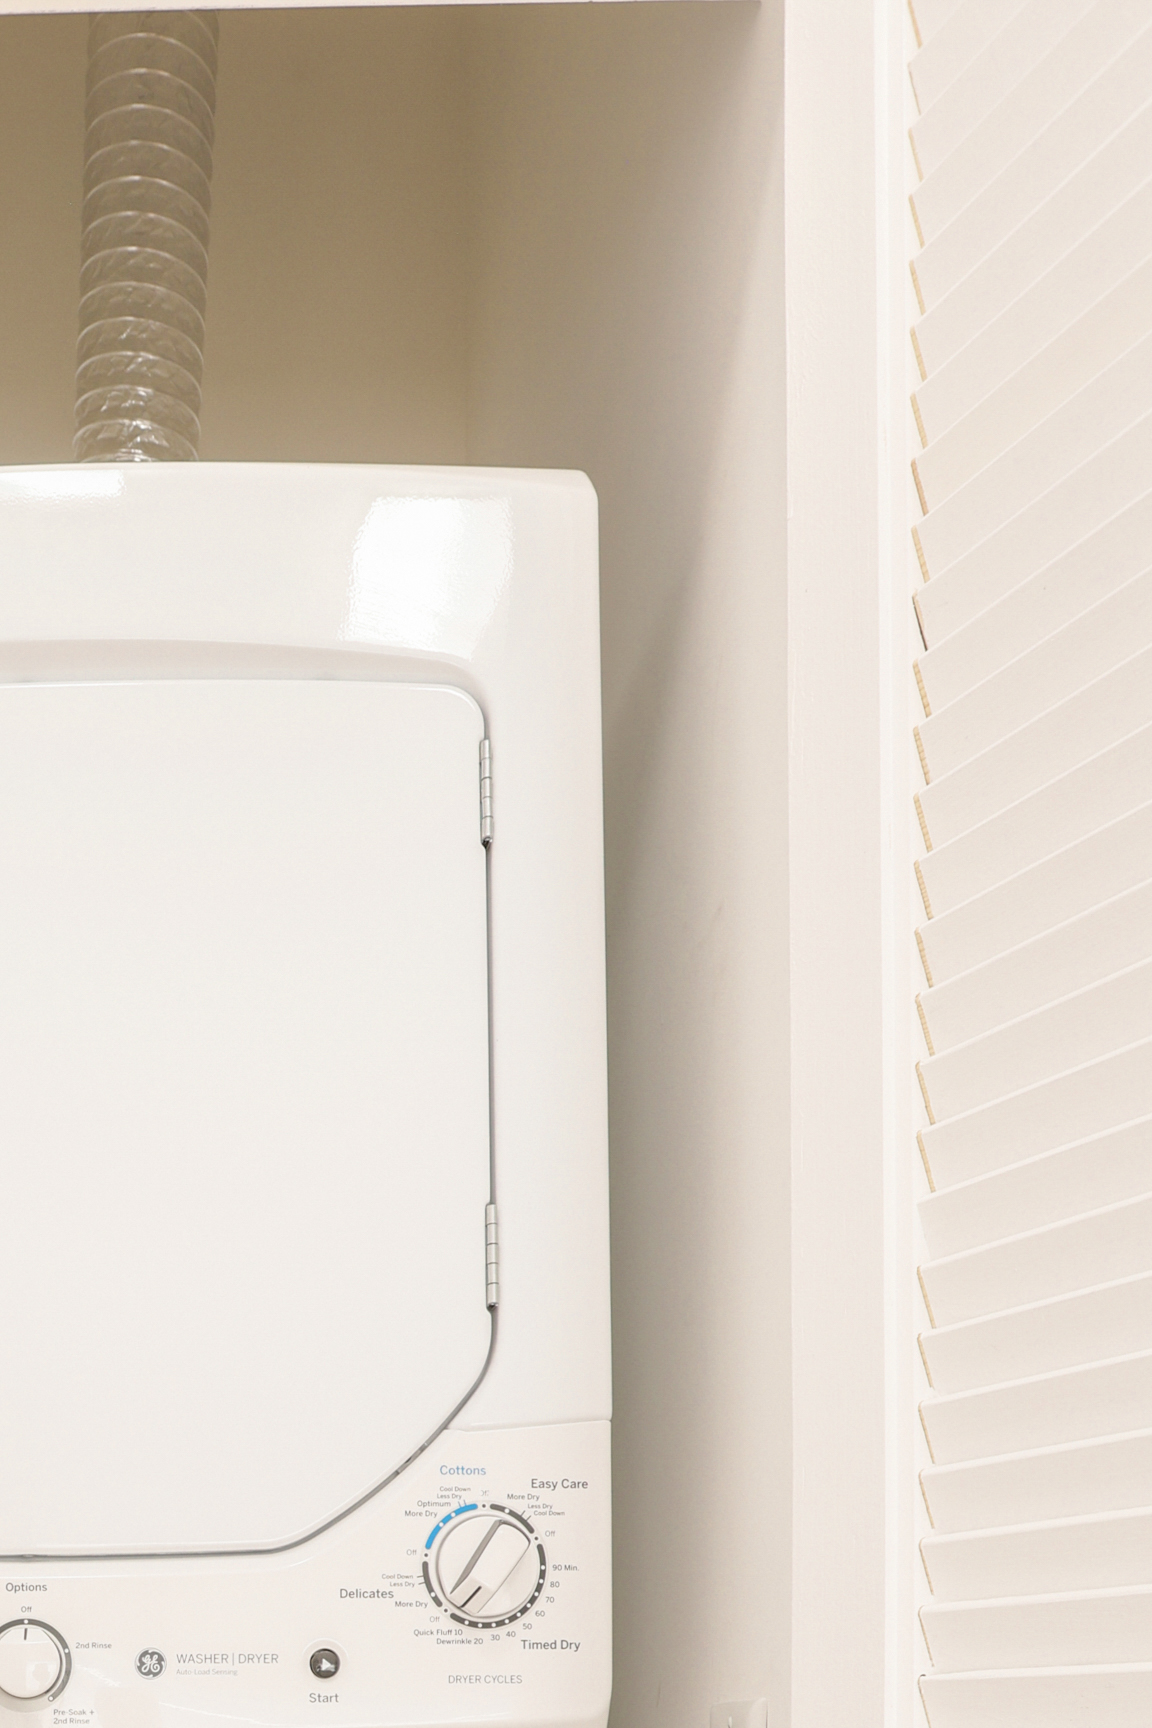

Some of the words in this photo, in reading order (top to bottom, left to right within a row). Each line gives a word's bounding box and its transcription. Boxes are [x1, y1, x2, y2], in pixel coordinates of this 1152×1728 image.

[440, 1465, 486, 1475] Cottons
[531, 1479, 558, 1490] Easy
[561, 1479, 588, 1489] Care
[6, 1583, 47, 1593] Options
[340, 1589, 394, 1598] Delicates
[521, 1640, 557, 1649] Timed
[561, 1640, 580, 1652] Dry
[177, 1654, 228, 1663] WASHER
[239, 1654, 278, 1663] DRYER
[448, 1676, 481, 1684] DRYER
[484, 1675, 522, 1683] CYCLES
[309, 1693, 338, 1702] Start
